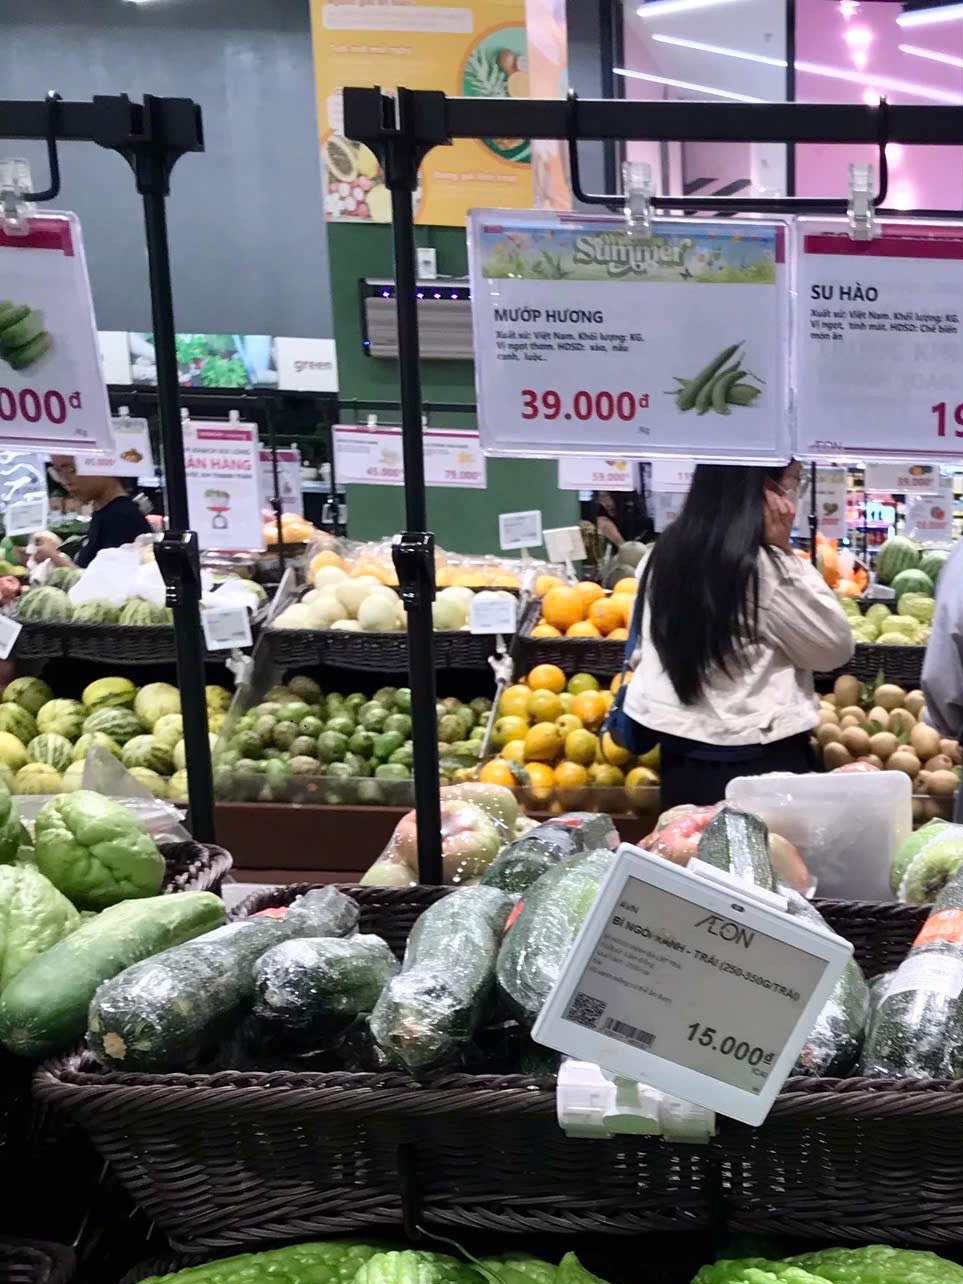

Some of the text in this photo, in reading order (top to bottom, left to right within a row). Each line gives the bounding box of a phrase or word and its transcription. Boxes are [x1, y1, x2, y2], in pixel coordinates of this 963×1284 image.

[811, 282, 878, 302] SU HÀO
[494, 307, 604, 324] MƯỚP HƯƠNG
